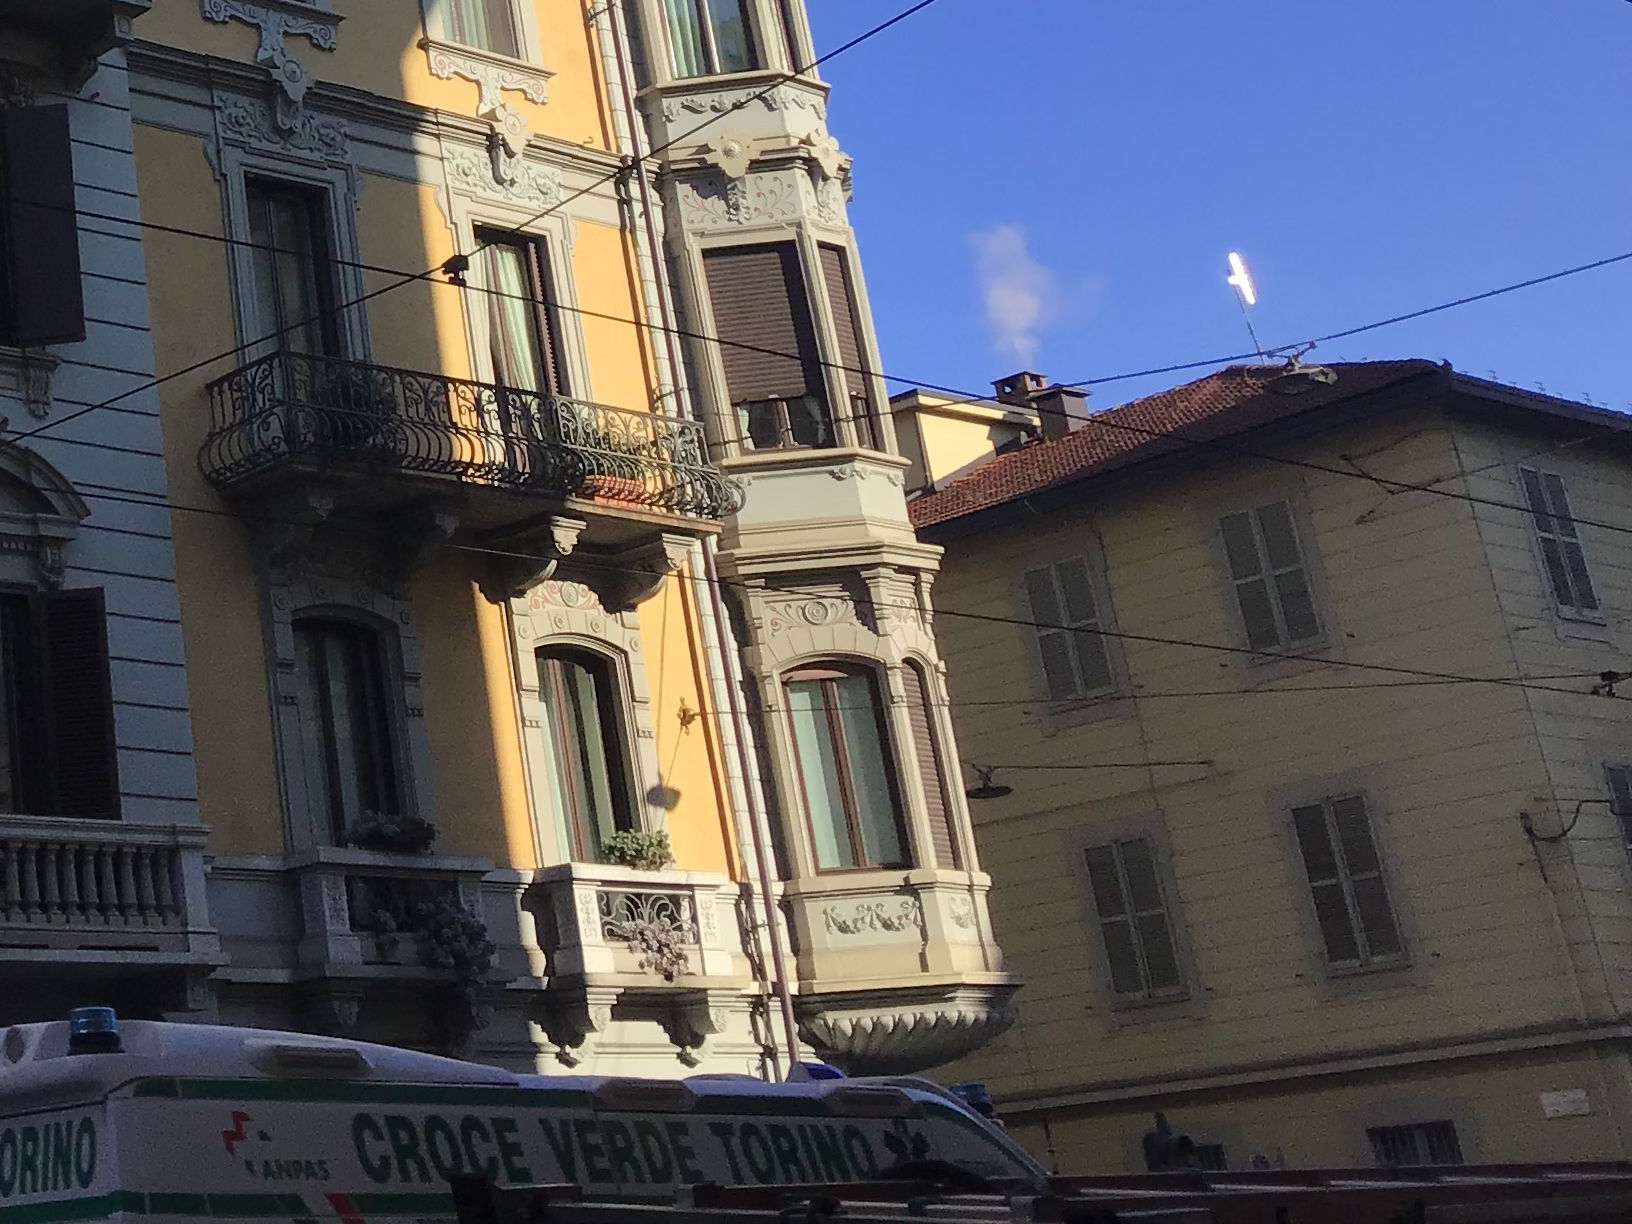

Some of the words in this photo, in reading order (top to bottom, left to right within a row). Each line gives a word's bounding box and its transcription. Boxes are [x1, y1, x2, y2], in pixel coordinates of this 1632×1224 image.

[352, 1112, 531, 1184] CROCE
[539, 1117, 705, 1184] VERDE
[708, 1121, 879, 1185] TORINO
